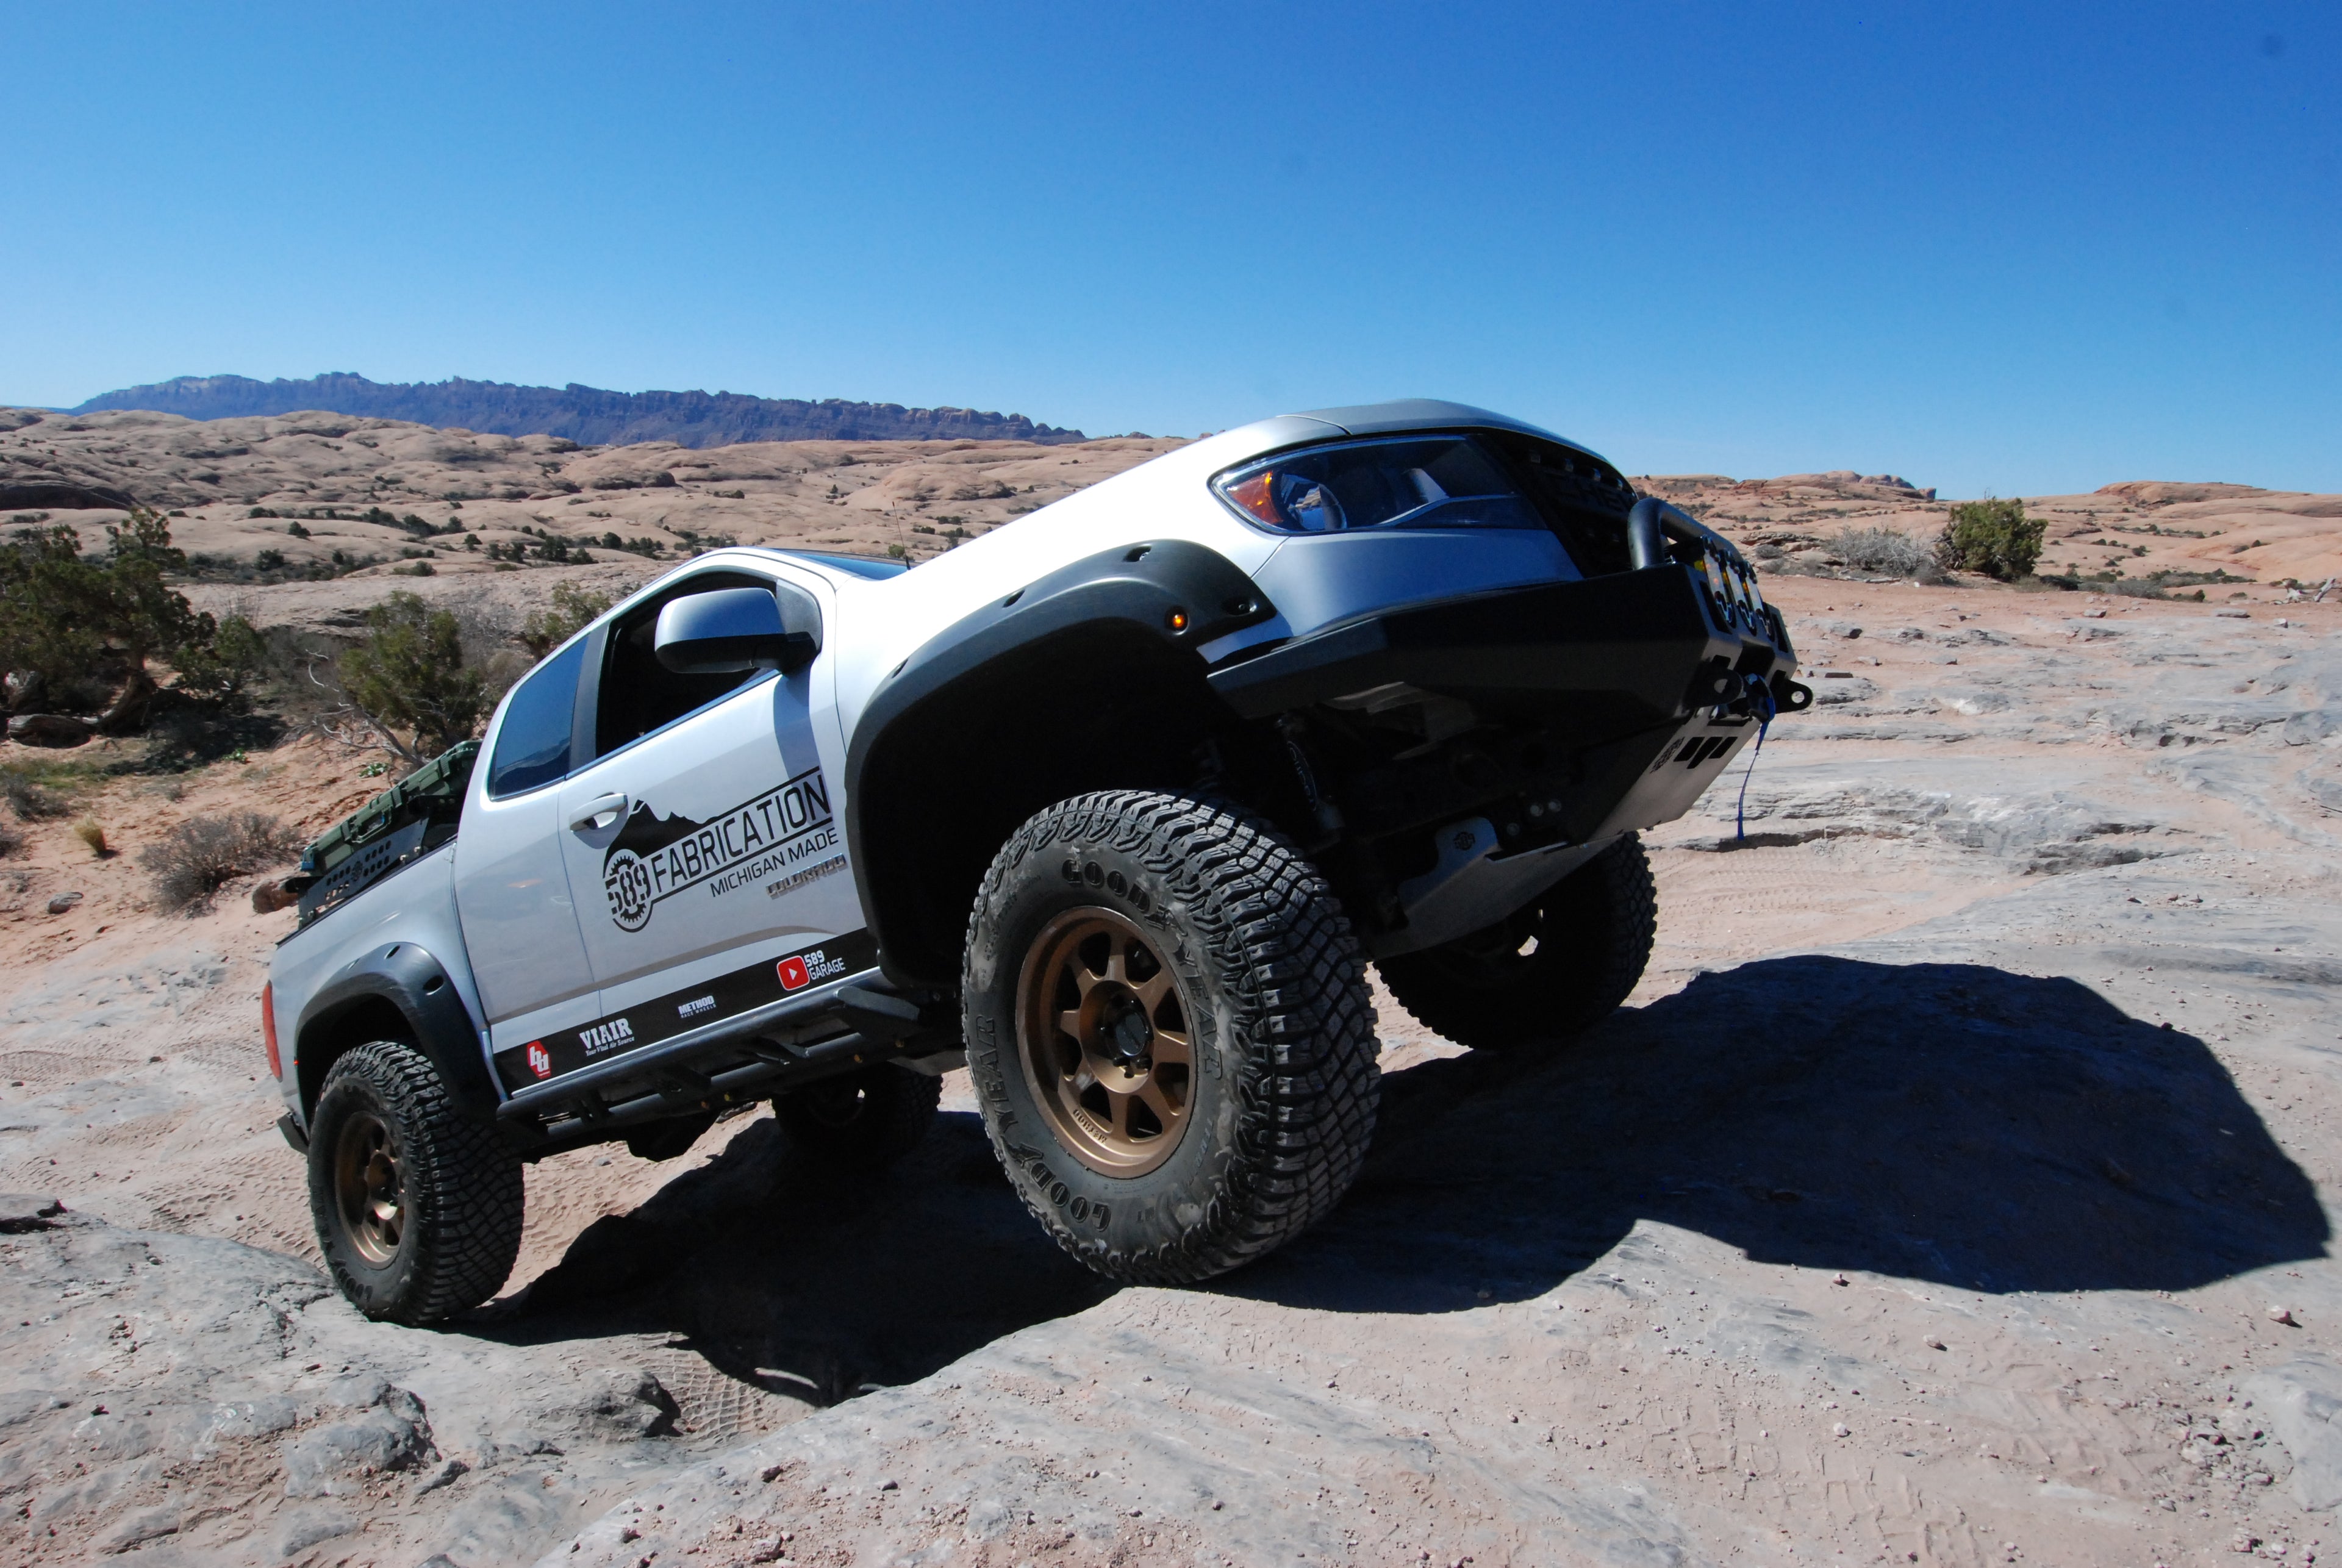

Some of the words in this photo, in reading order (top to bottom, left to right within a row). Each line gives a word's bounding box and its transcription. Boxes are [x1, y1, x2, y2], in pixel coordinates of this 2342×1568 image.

[605, 863, 651, 915] 589
[650, 774, 831, 893] FABRICATION
[710, 851, 786, 898] MICHIGAN
[787, 827, 839, 862] MADE
[803, 950, 825, 968] 589
[808, 957, 846, 980] GARAGE
[678, 995, 714, 1014] METHOD
[579, 1017, 633, 1049] VIAIR
[1072, 1109, 1107, 1144] METHOD
